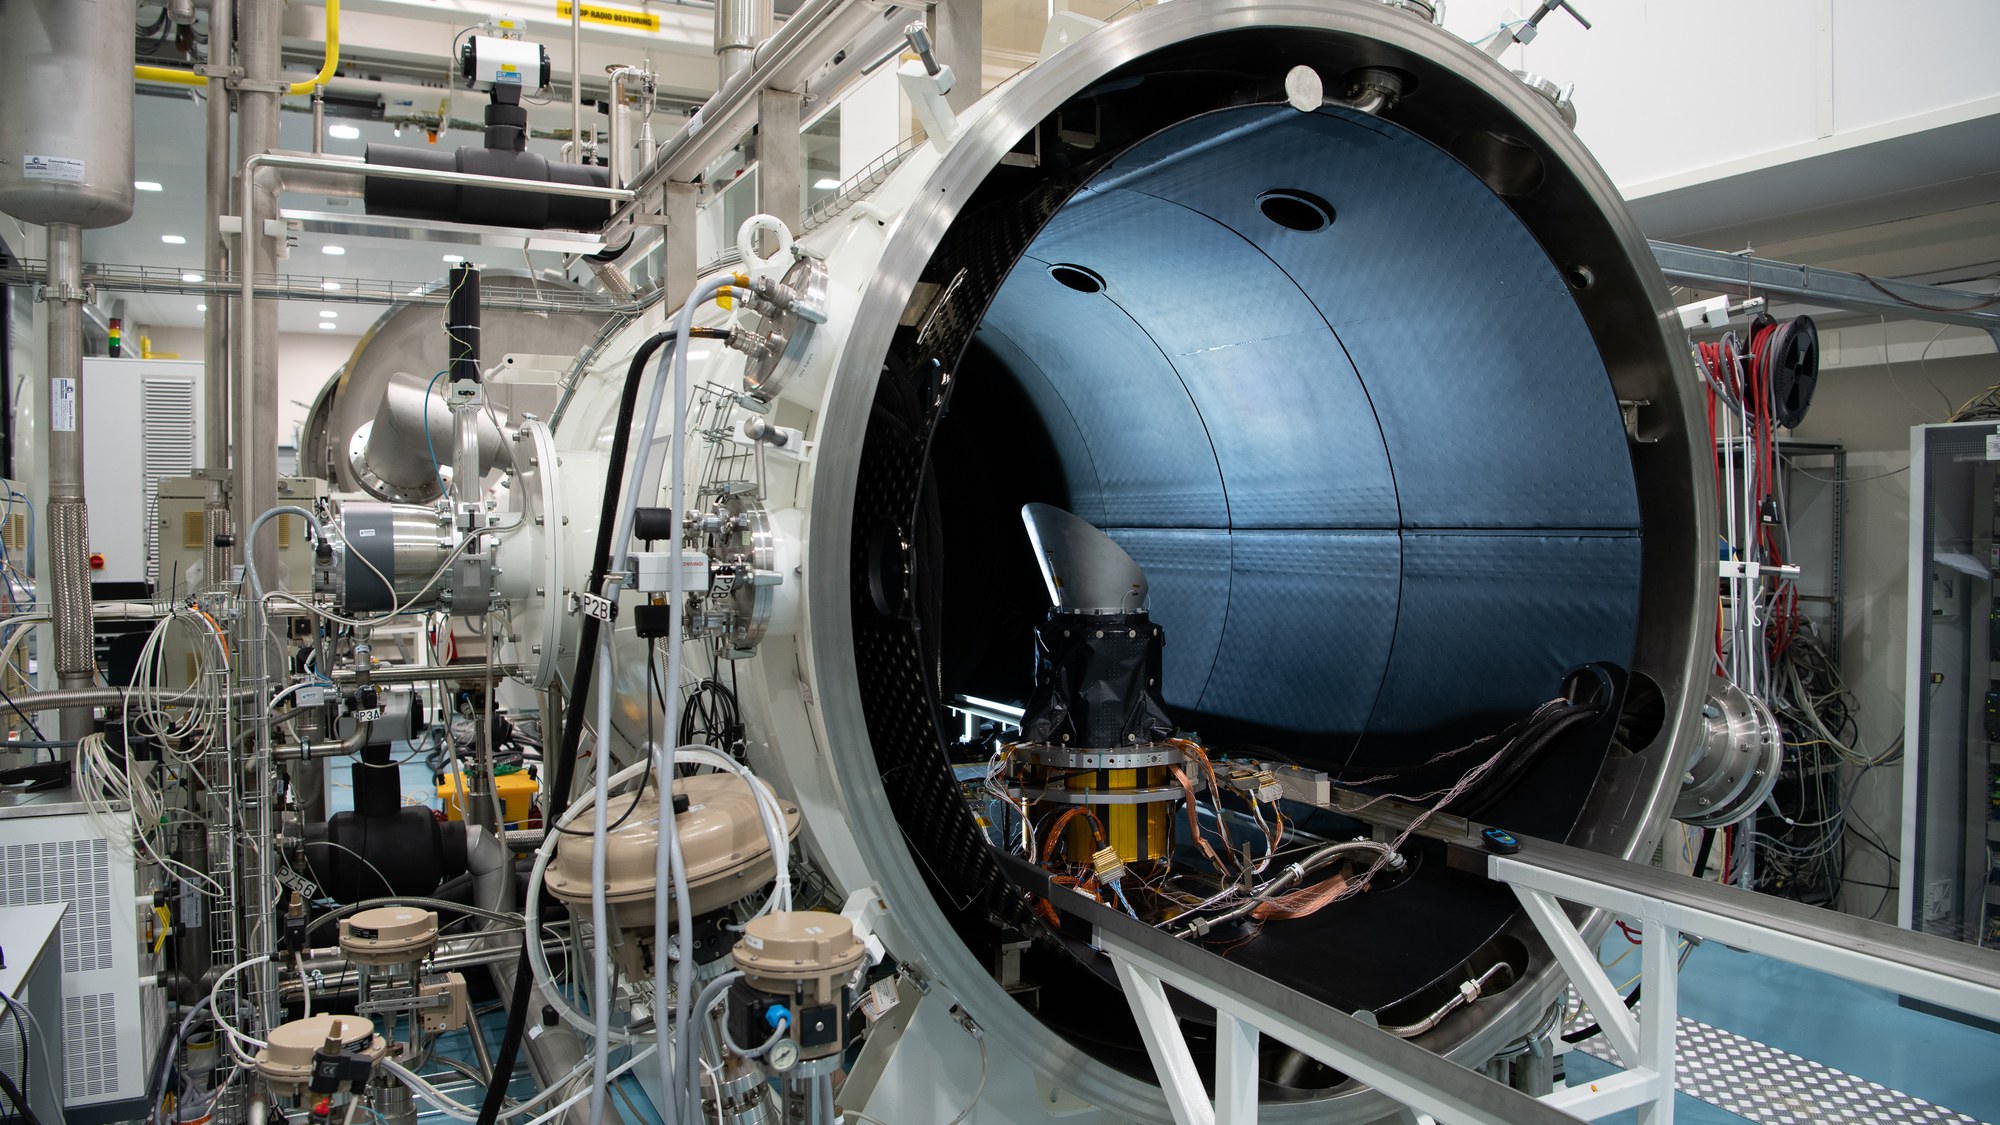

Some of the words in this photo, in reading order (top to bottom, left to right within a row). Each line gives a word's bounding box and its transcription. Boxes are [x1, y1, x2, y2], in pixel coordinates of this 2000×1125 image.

[591, 10, 612, 20] RADIO
[614, 14, 652, 26] BESTURING
[712, 578, 733, 598] P2B
[584, 595, 608, 619] P2B
[359, 710, 380, 721] P3A
[276, 867, 315, 897] PZ56
